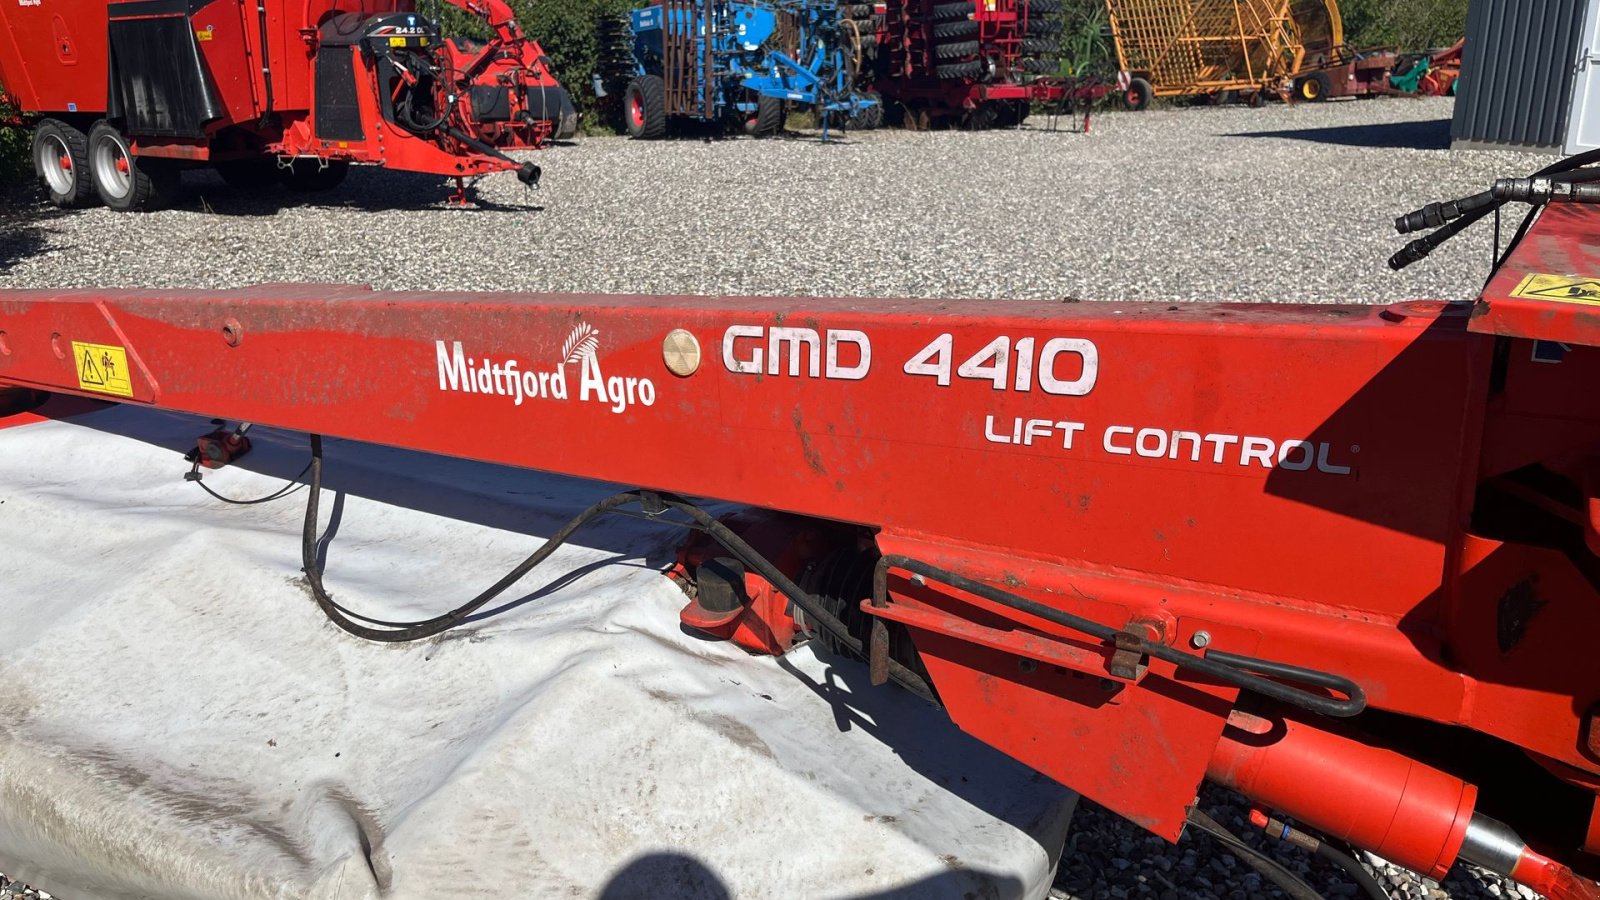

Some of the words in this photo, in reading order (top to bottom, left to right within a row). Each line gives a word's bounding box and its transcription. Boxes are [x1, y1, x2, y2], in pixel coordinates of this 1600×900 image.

[435, 340, 568, 406] Midtfjord
[580, 349, 656, 414] Agro
[722, 324, 872, 380] GMD
[903, 333, 1099, 397] 4410
[984, 414, 1085, 449] LIFT
